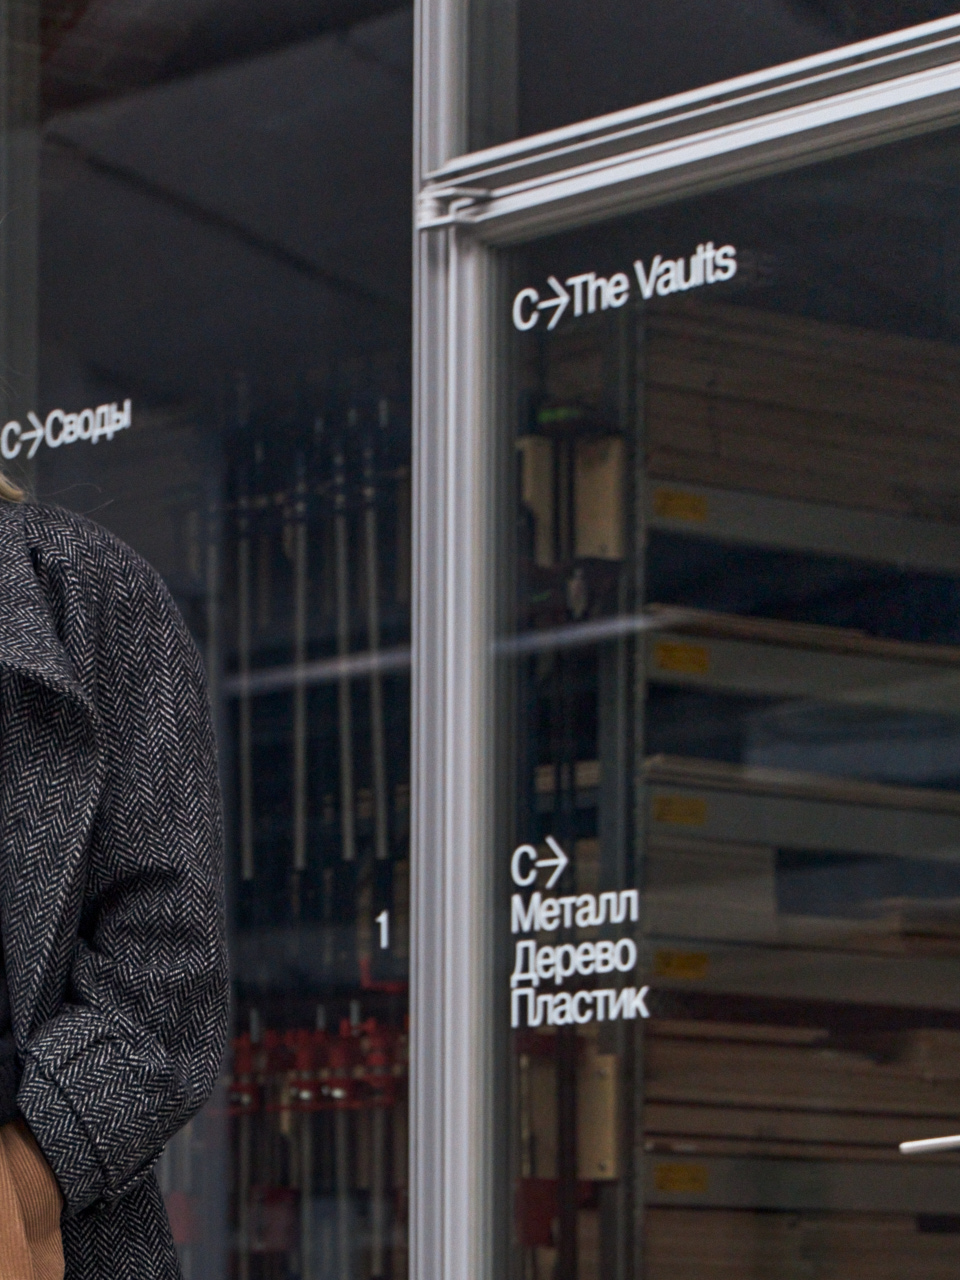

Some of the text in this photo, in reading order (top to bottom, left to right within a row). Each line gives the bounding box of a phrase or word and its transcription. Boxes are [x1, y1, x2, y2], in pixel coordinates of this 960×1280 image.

[565, 271, 630, 317] The
[633, 241, 737, 300] Vaults
[45, 398, 132, 448] Своды
[374, 909, 389, 949] 1
[510, 889, 640, 934] Металл
[510, 937, 638, 988] Дерево
[510, 985, 651, 1028] Пластик
